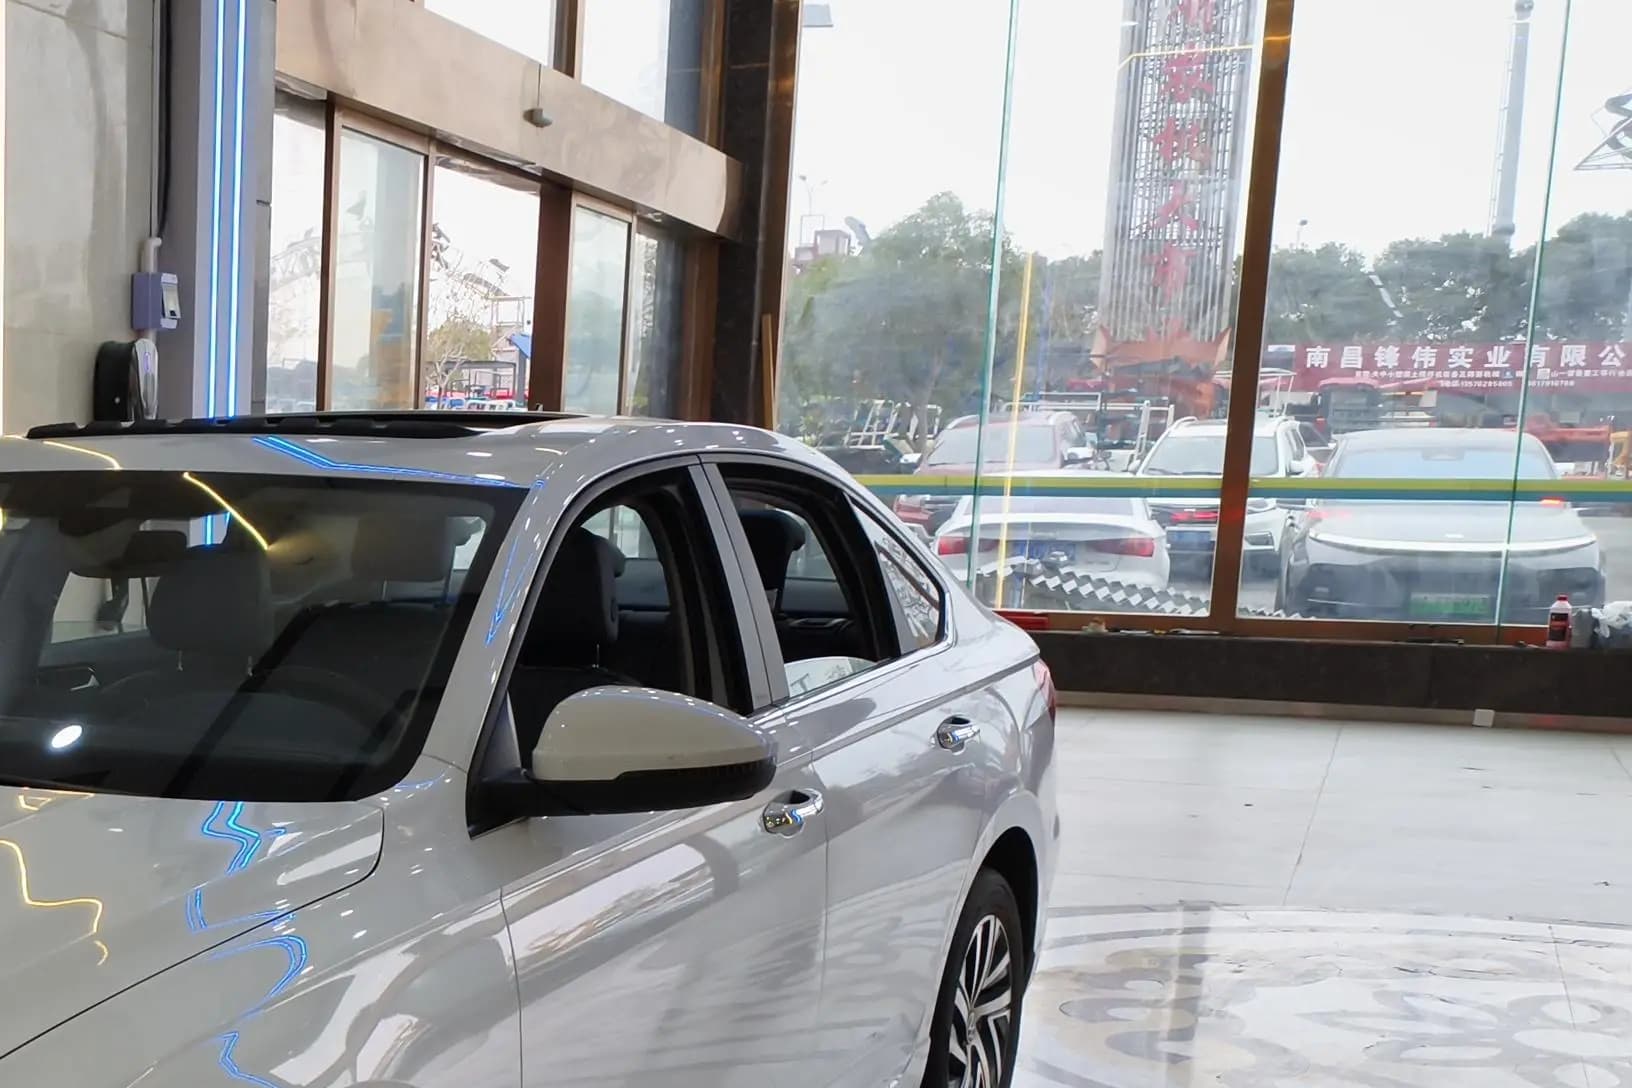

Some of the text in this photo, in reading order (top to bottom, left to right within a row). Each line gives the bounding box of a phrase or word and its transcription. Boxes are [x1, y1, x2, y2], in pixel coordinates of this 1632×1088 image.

[1305, 343, 1627, 369] 南昌锋伟实业有限公
